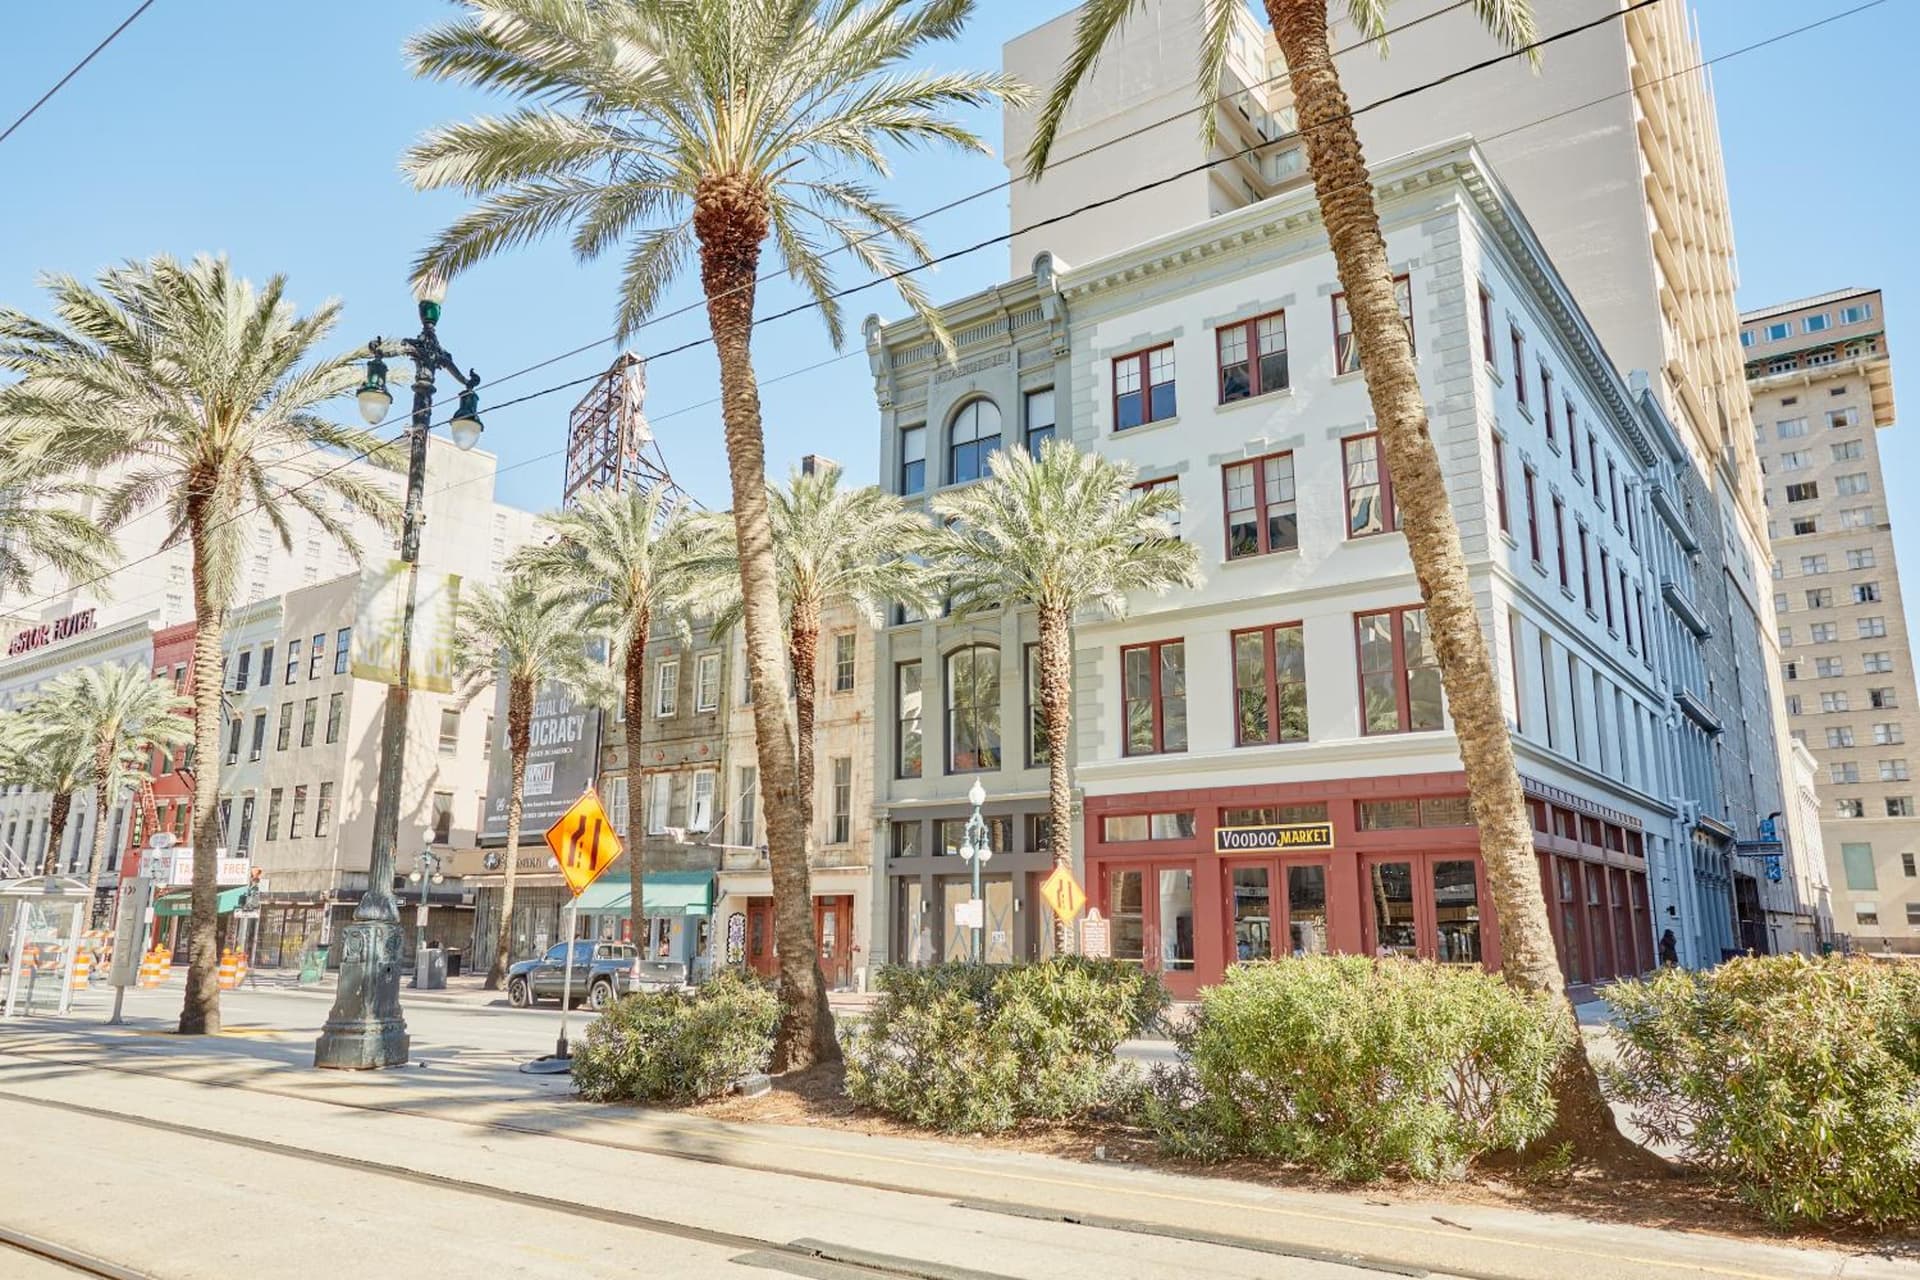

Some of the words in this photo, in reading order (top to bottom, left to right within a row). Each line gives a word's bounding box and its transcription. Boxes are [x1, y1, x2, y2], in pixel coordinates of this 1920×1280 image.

[502, 714, 586, 752] DOCRACY
[1222, 831, 1277, 848] VOODOO
[1277, 829, 1328, 847] MARKET
[223, 862, 246, 874] FREE
